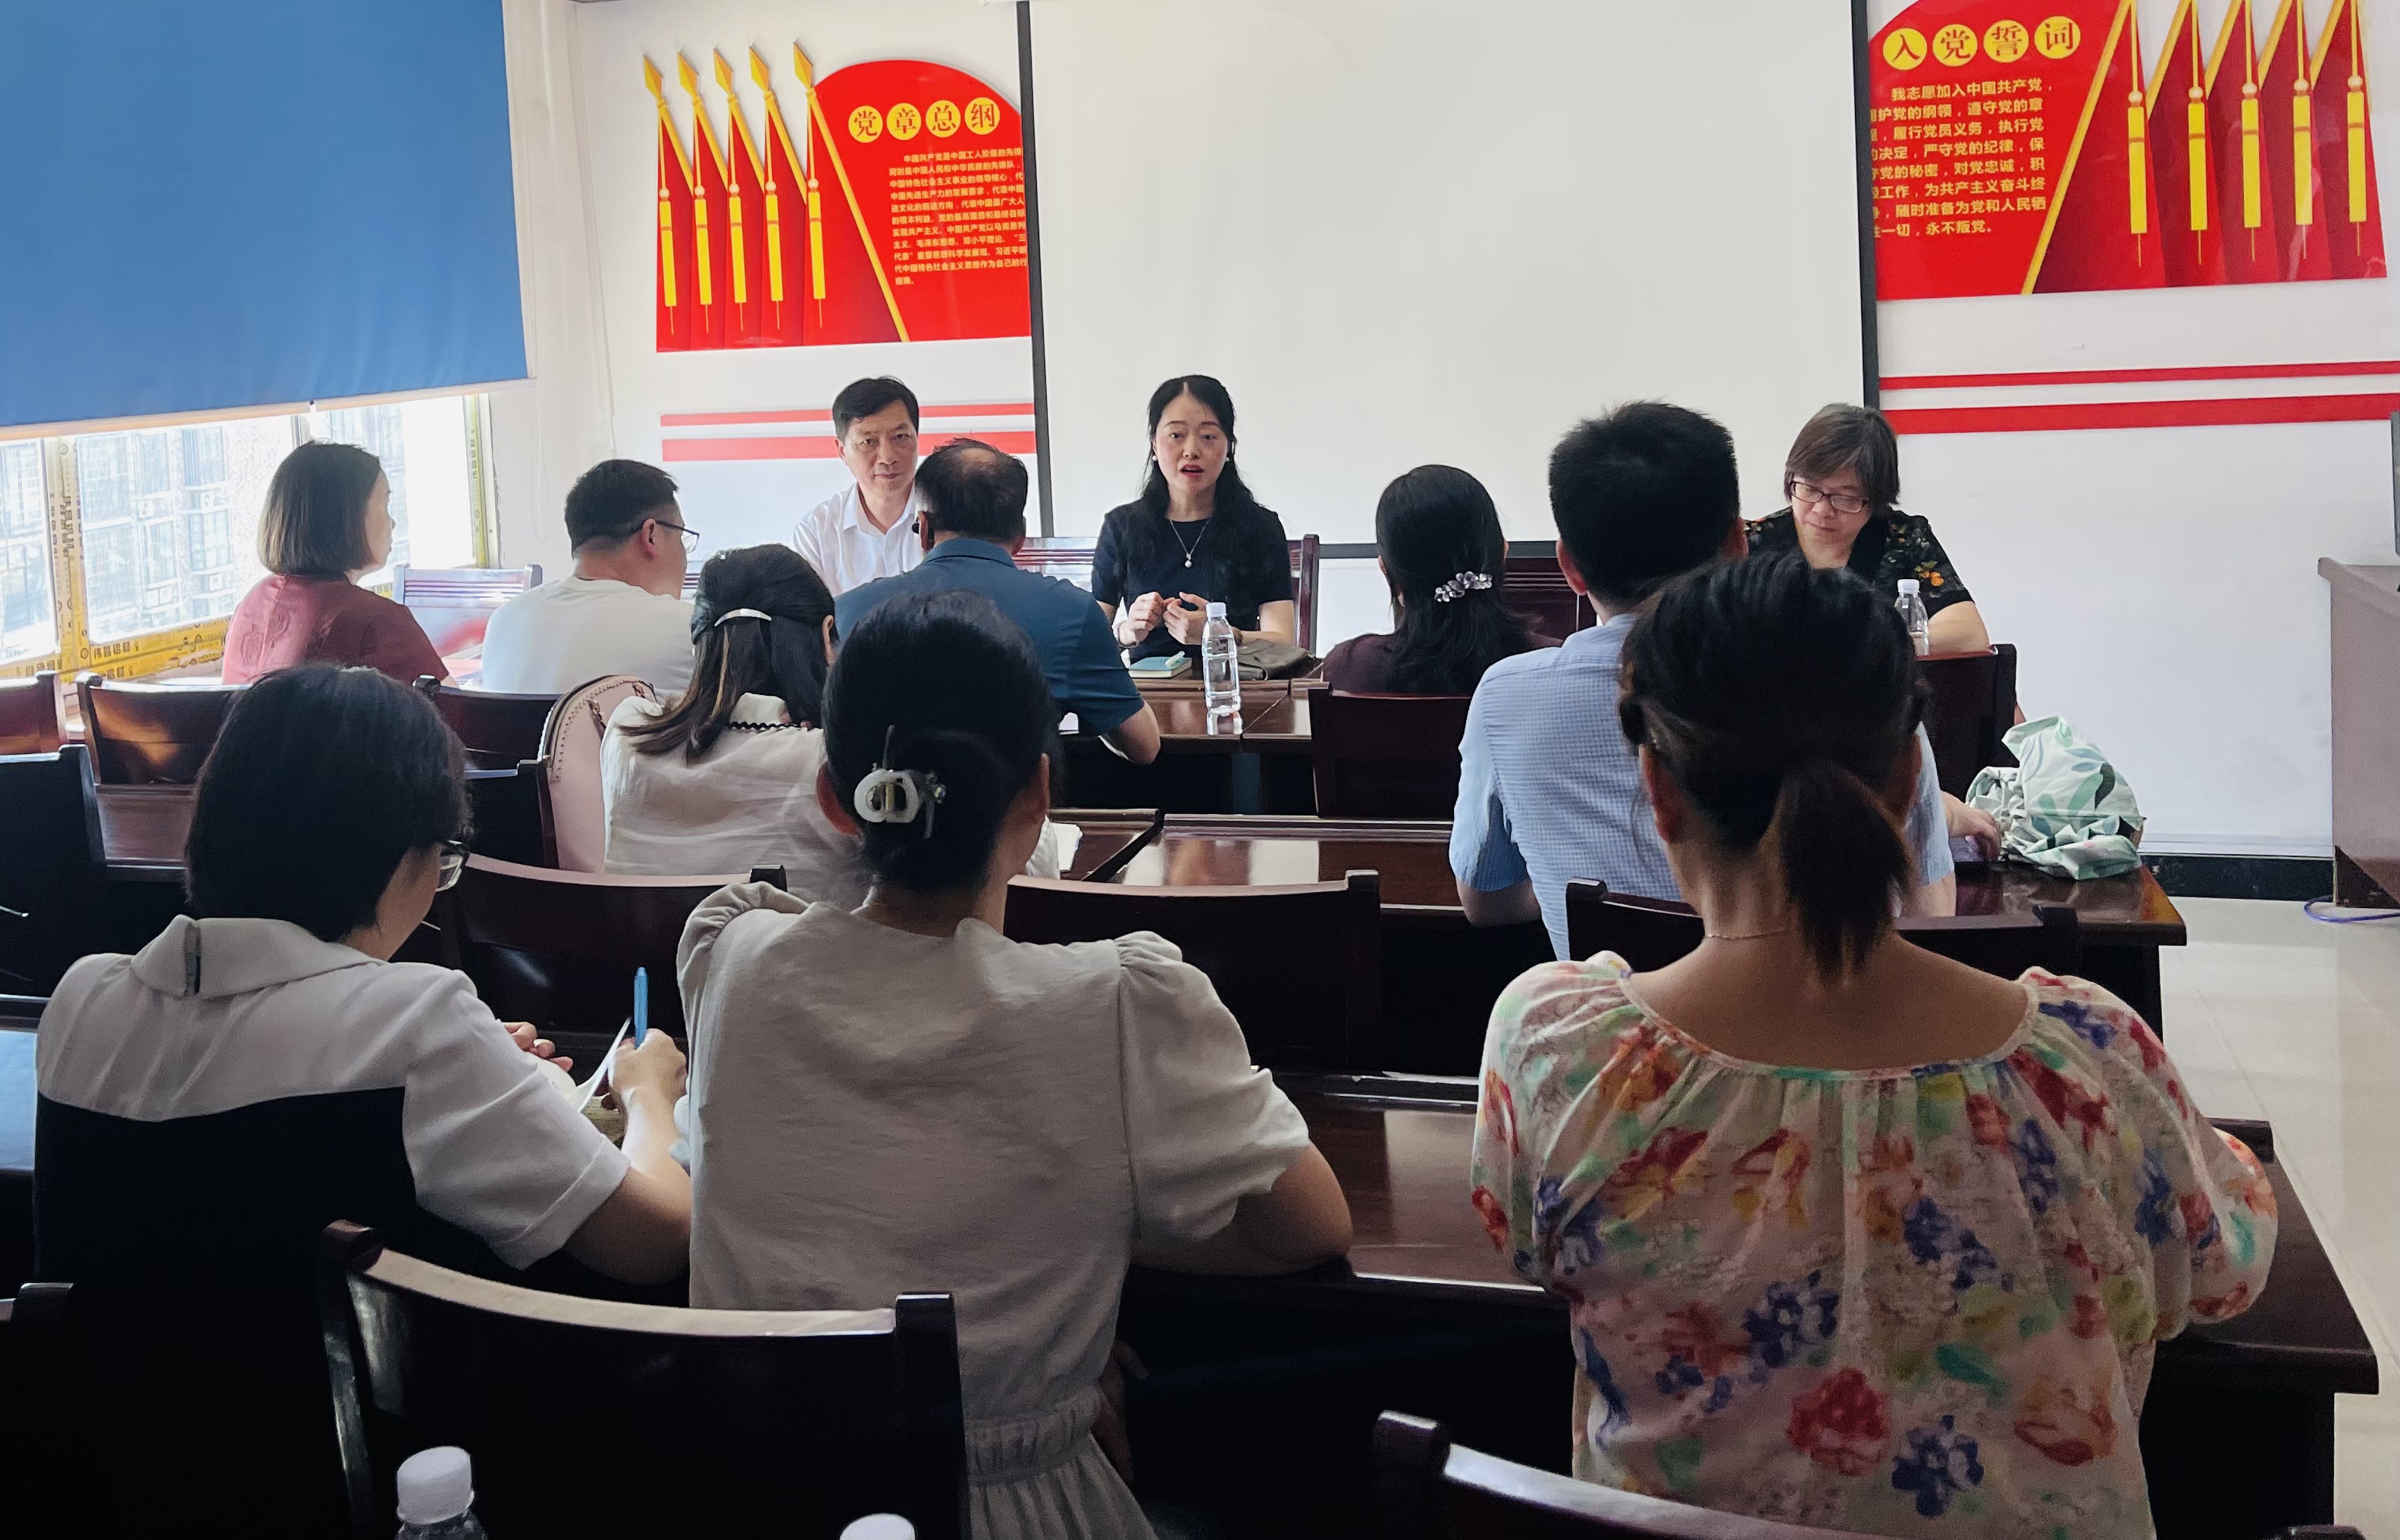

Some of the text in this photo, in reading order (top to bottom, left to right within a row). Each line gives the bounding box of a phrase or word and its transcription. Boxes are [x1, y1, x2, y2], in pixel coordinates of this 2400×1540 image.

[1892, 21, 2074, 61] 入党誓词
[1891, 78, 2051, 101] 我志愿加入中国共产党，
[854, 103, 995, 137] 党章总纲
